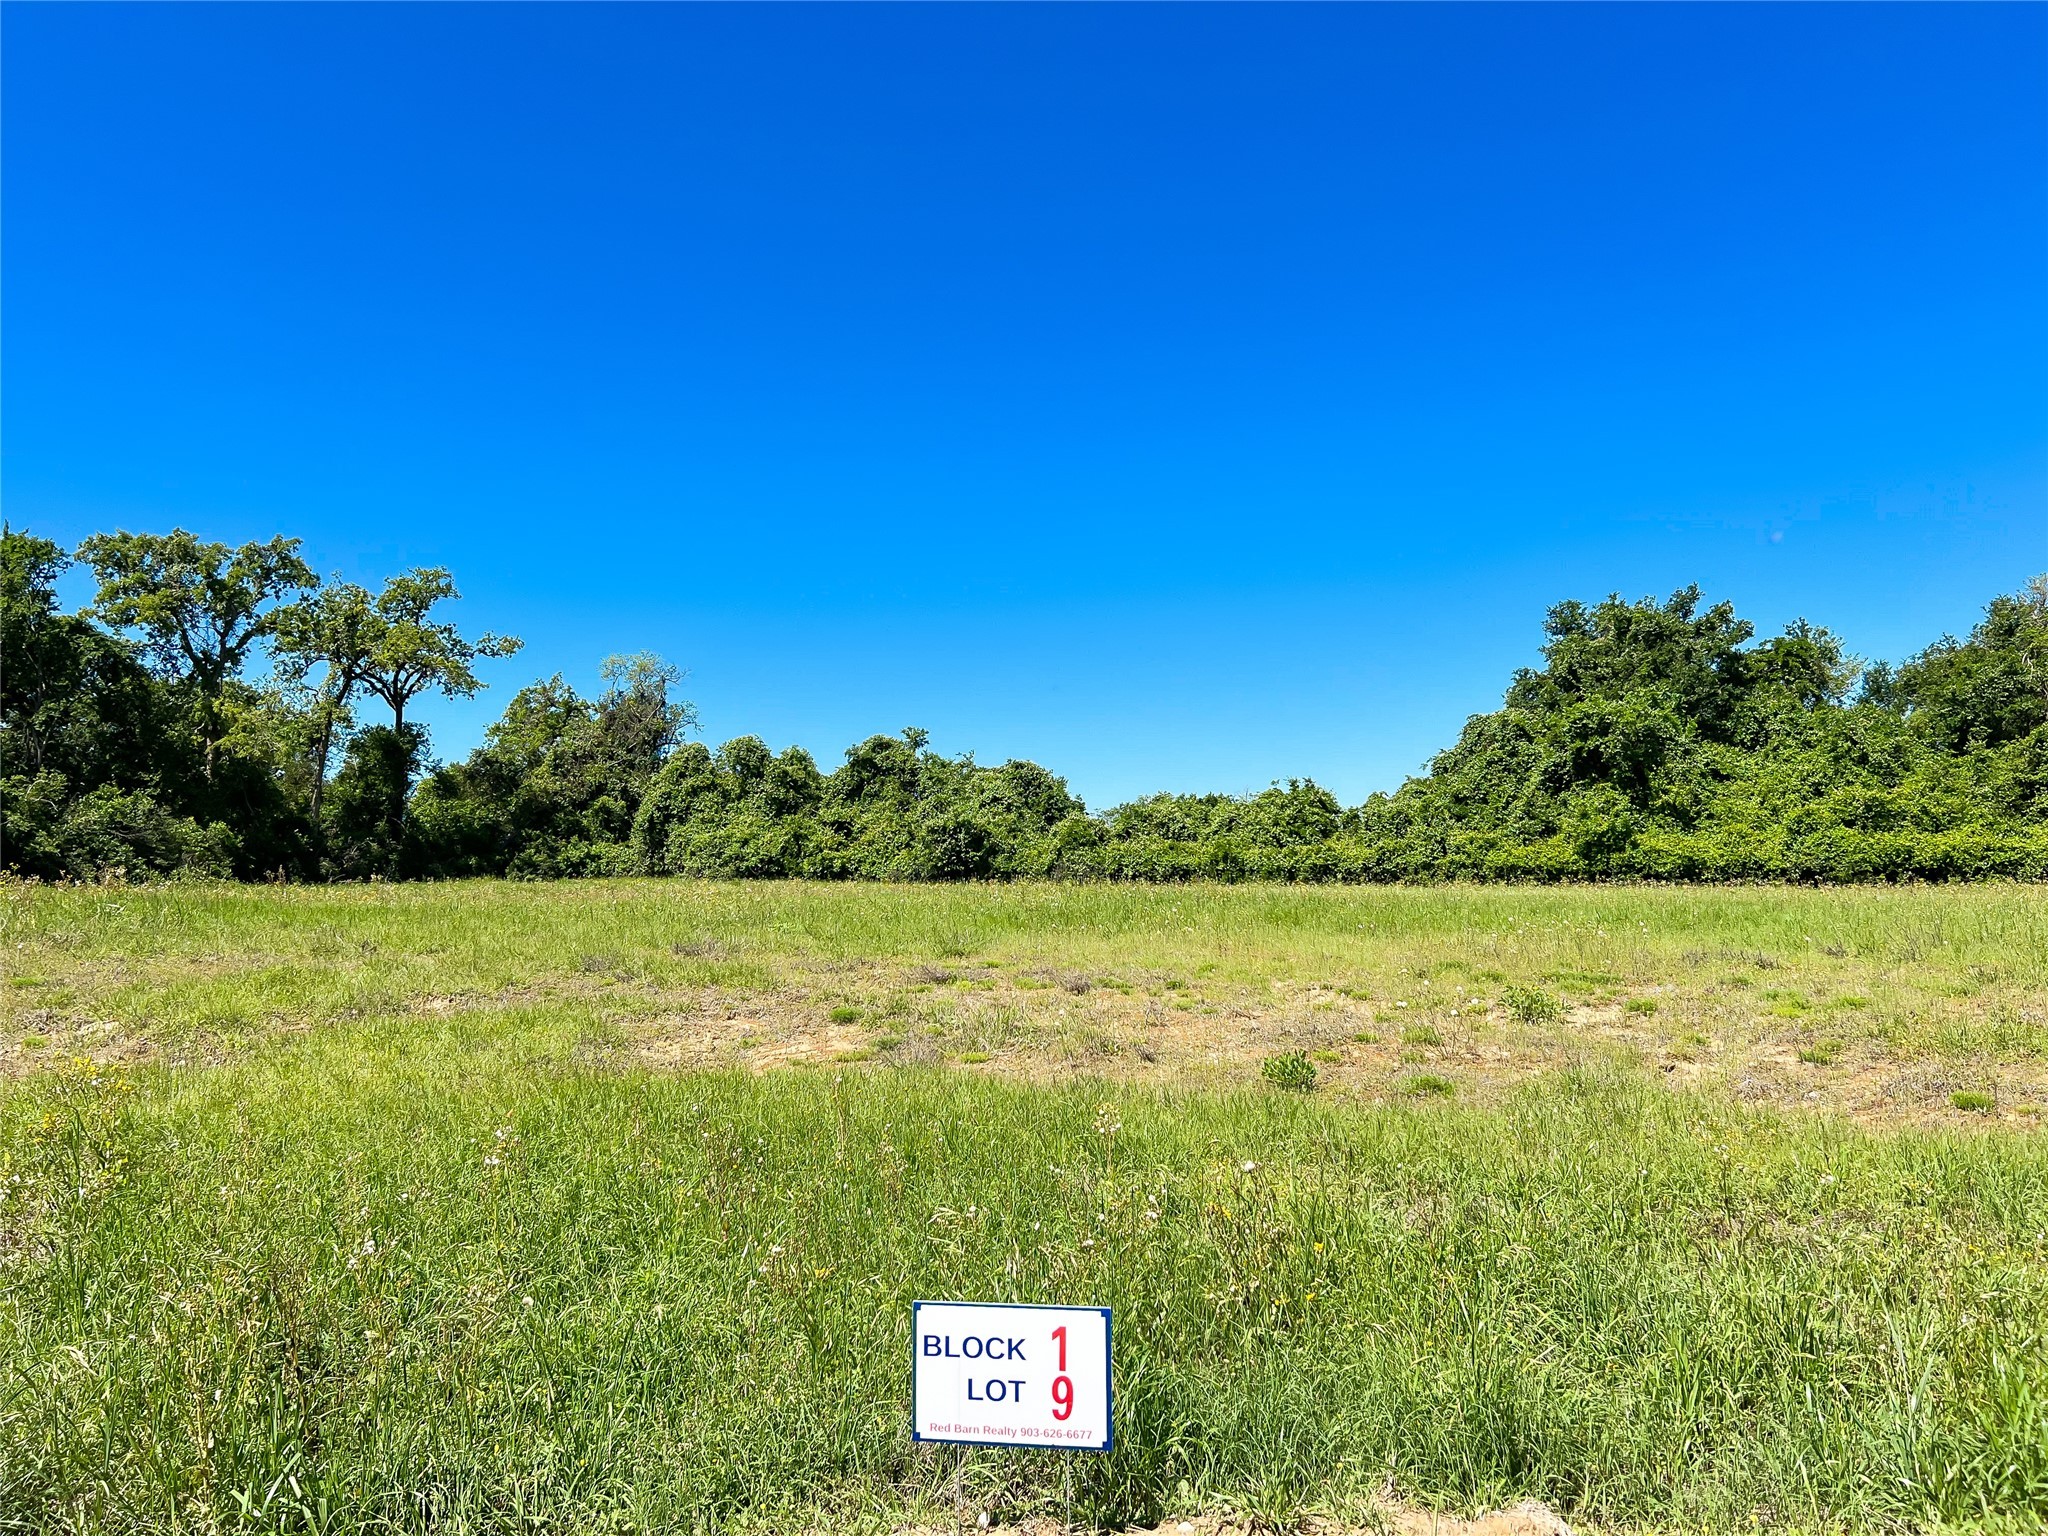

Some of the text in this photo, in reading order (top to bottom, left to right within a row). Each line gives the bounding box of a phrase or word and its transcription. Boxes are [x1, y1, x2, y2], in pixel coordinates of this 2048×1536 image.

[923, 1326, 1067, 1371] BLOCK 1
[967, 1375, 1074, 1421] LOT 9
[929, 1423, 1093, 1440] Red Barn Realty 903-626-6677
